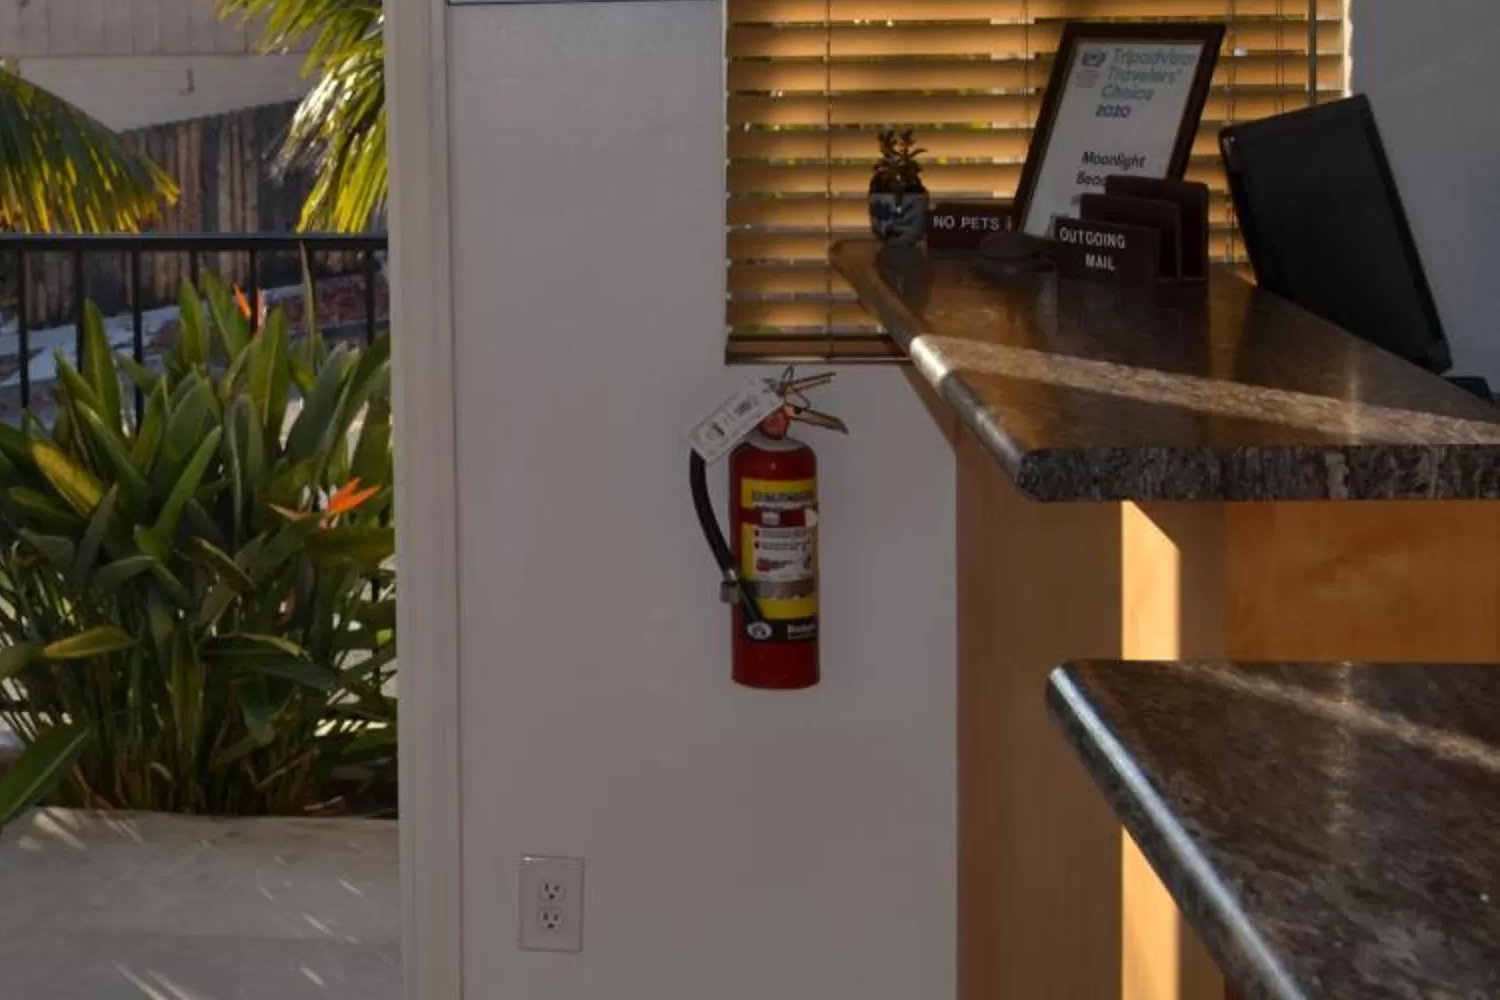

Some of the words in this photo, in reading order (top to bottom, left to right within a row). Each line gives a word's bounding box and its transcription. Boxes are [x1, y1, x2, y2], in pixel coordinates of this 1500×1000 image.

[1095, 103, 1132, 118] 2020
[1081, 150, 1147, 171] Moonlight
[933, 215, 955, 230] NO
[961, 215, 999, 231] PETS
[1059, 226, 1127, 250] OUTGOING
[1085, 253, 1117, 272] MAIL
